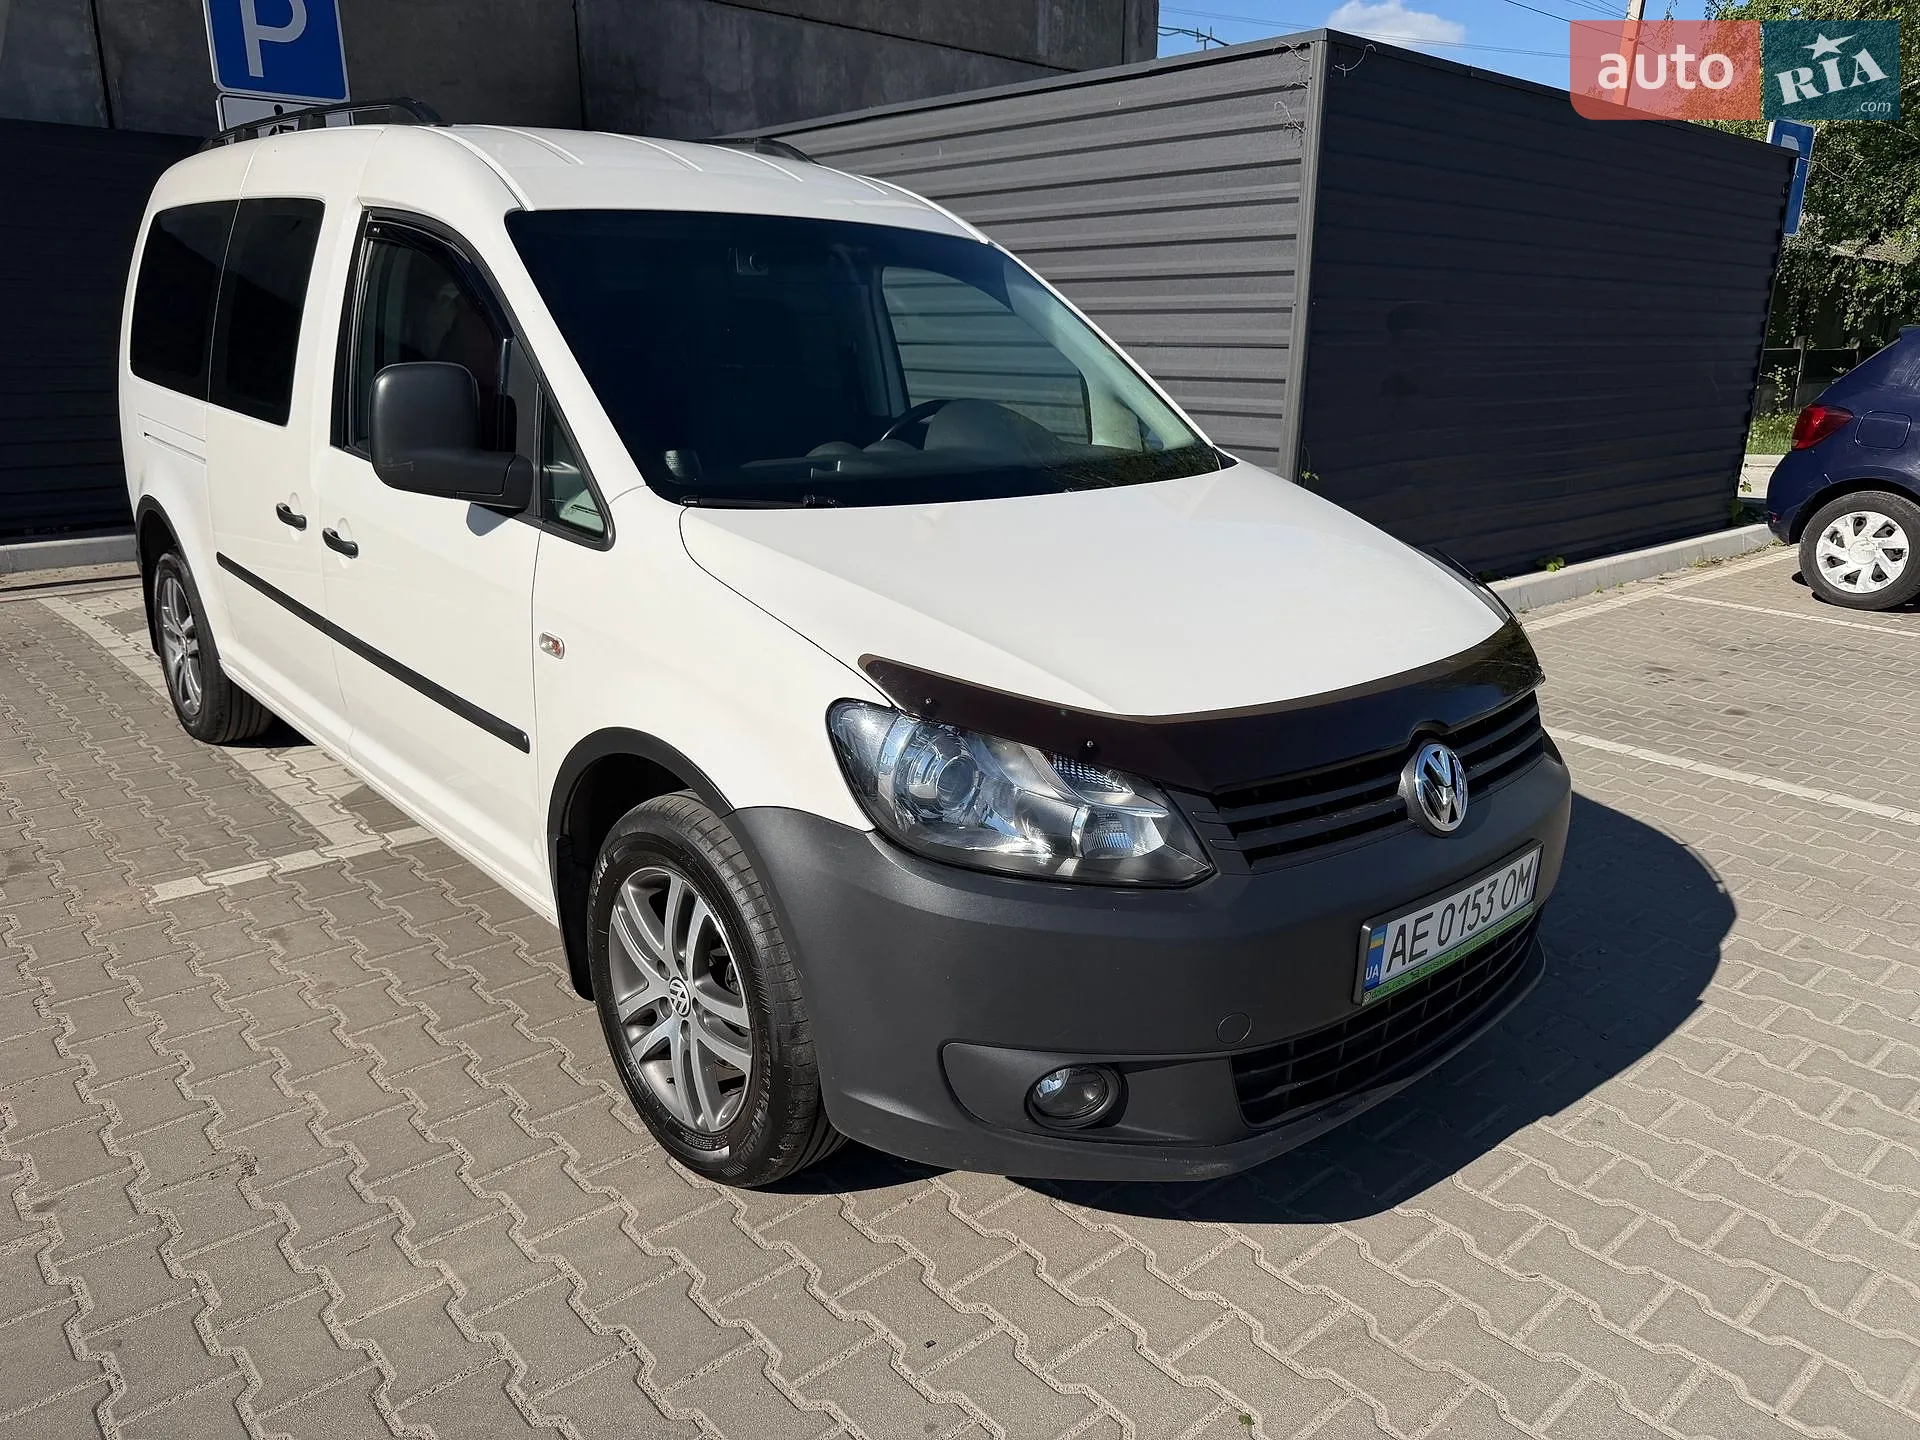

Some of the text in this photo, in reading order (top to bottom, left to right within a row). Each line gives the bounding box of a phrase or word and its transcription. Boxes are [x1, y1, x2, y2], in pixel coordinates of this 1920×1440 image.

[240, 0, 307, 77] P
[1385, 911, 1434, 973] AE
[1436, 878, 1499, 947] 0153
[1501, 857, 1534, 910] OM
[1365, 963, 1379, 981] UA
